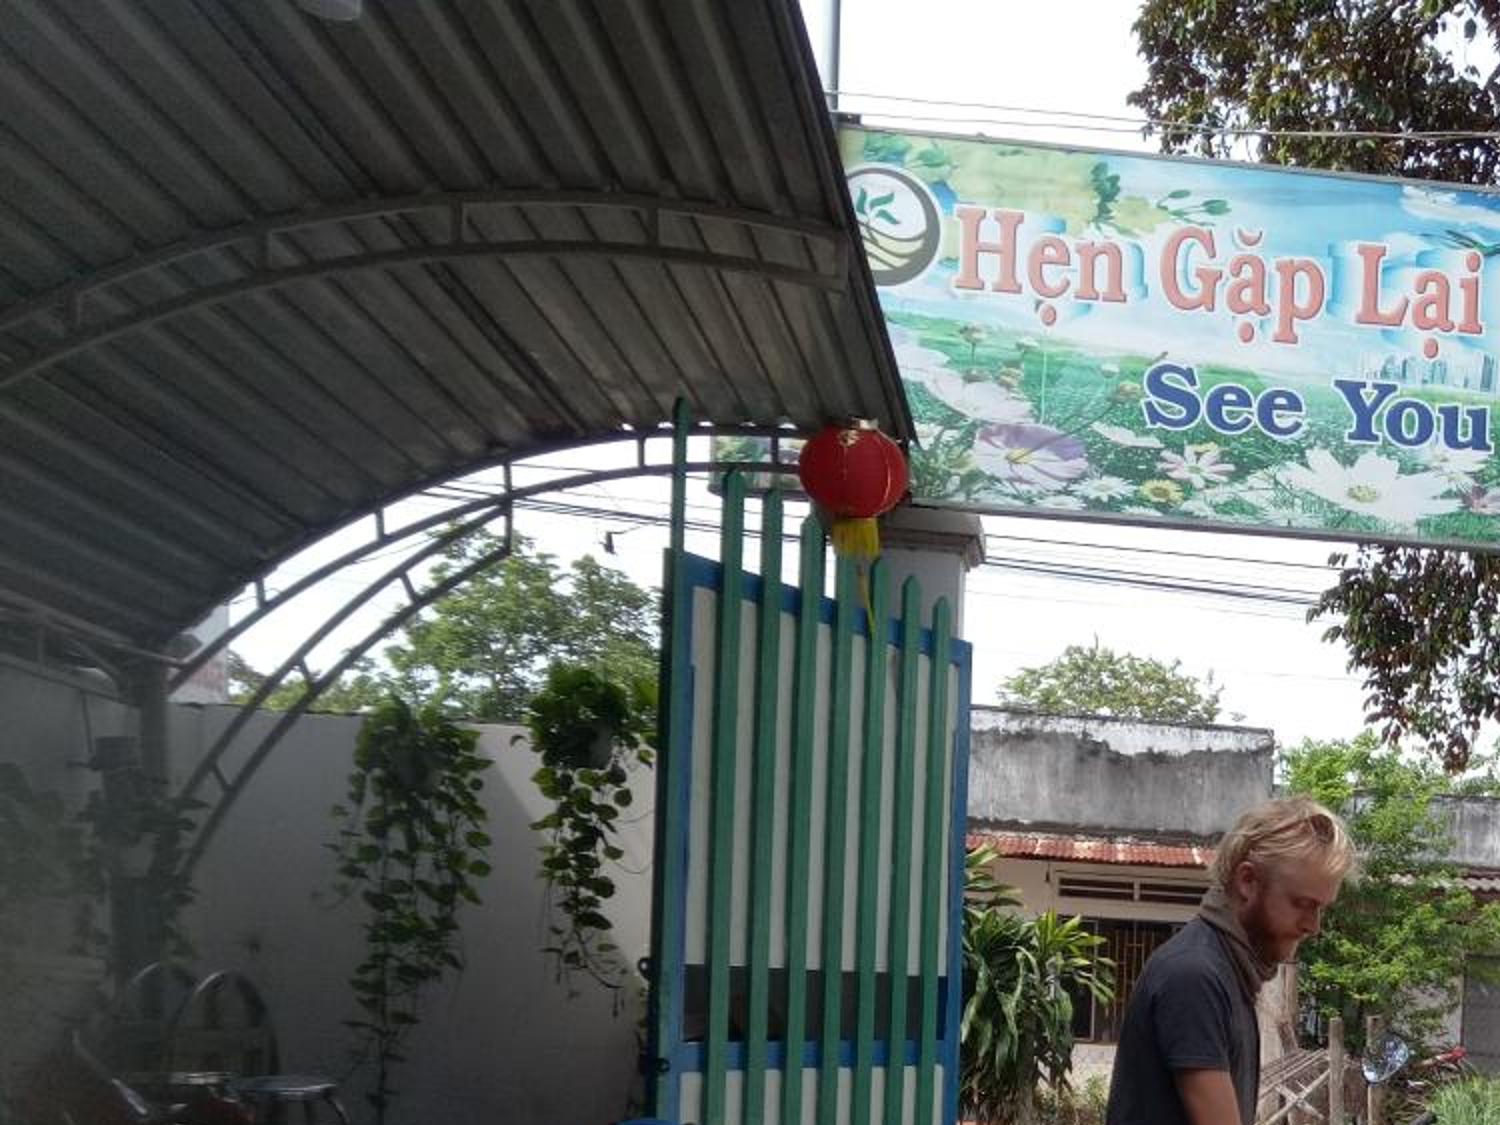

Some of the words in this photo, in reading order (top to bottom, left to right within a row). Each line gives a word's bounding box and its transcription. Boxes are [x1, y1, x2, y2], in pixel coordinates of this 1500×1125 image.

[954, 207, 1127, 327] Hẹn
[1160, 226, 1327, 345] Gặp
[1354, 243, 1483, 359] Lại
[1144, 365, 1303, 436] See
[1335, 379, 1492, 453] You
